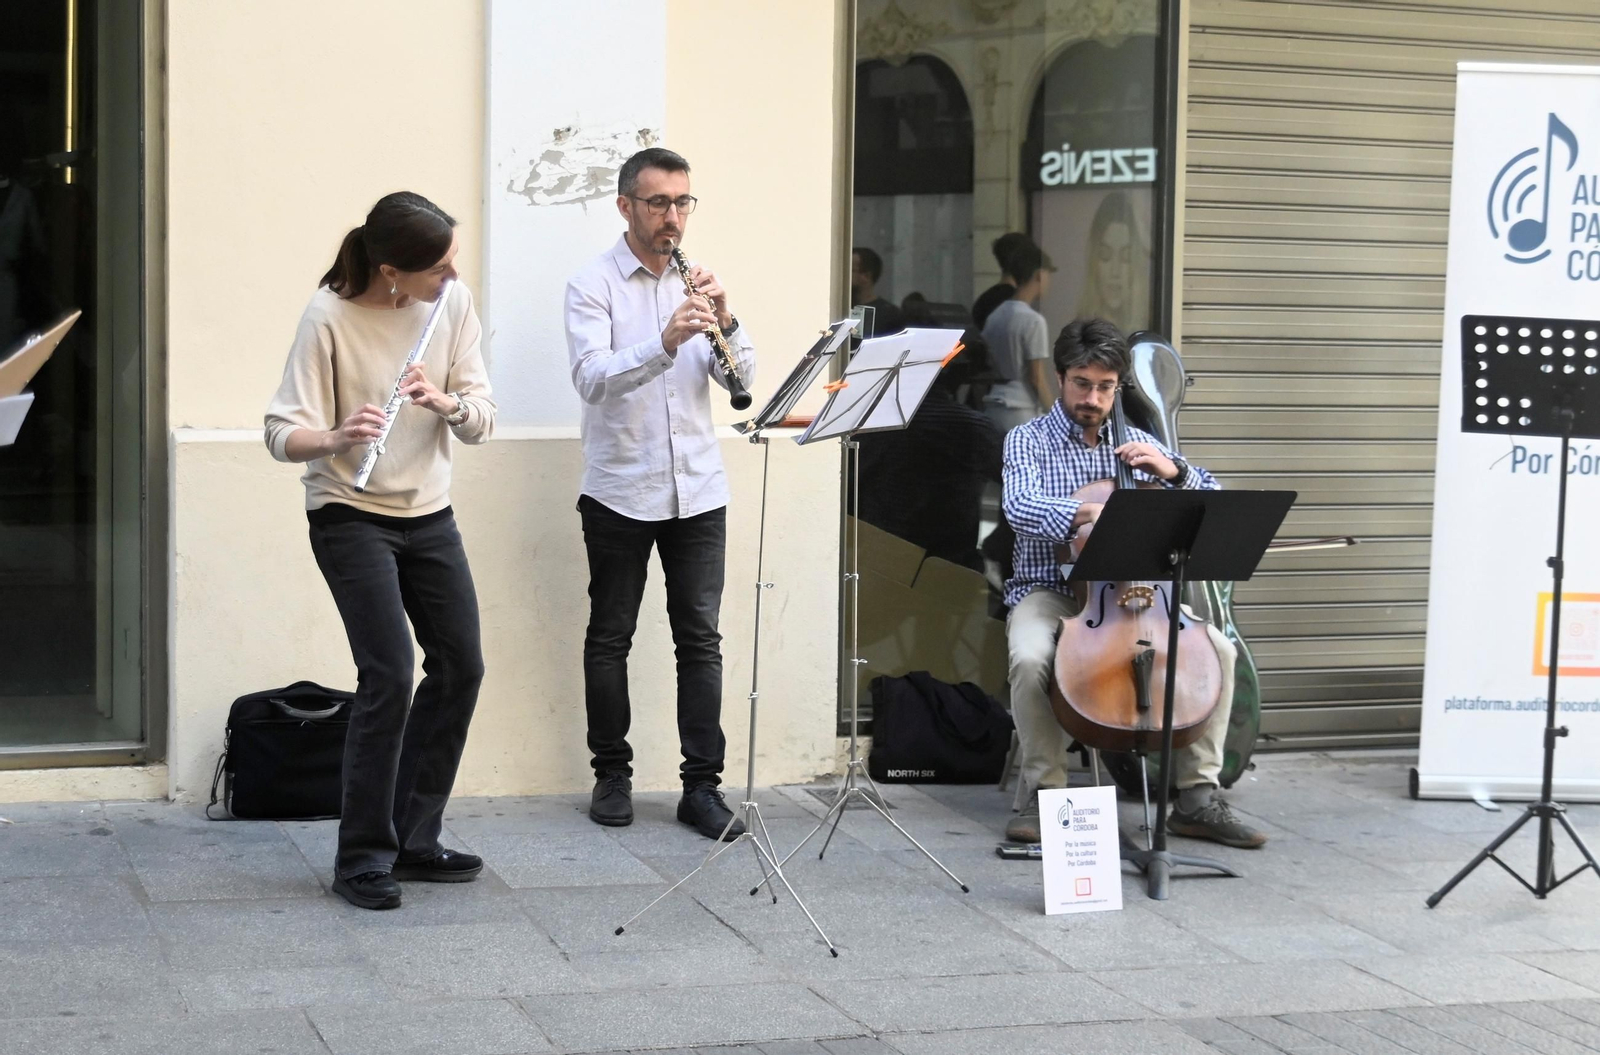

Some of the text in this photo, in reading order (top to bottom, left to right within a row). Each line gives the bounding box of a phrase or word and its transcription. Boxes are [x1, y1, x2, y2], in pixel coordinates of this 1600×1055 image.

[1511, 445, 1553, 474] Por
[887, 769, 936, 778] NORTH SIX
[1073, 808, 1100, 816] AUDITORIO
